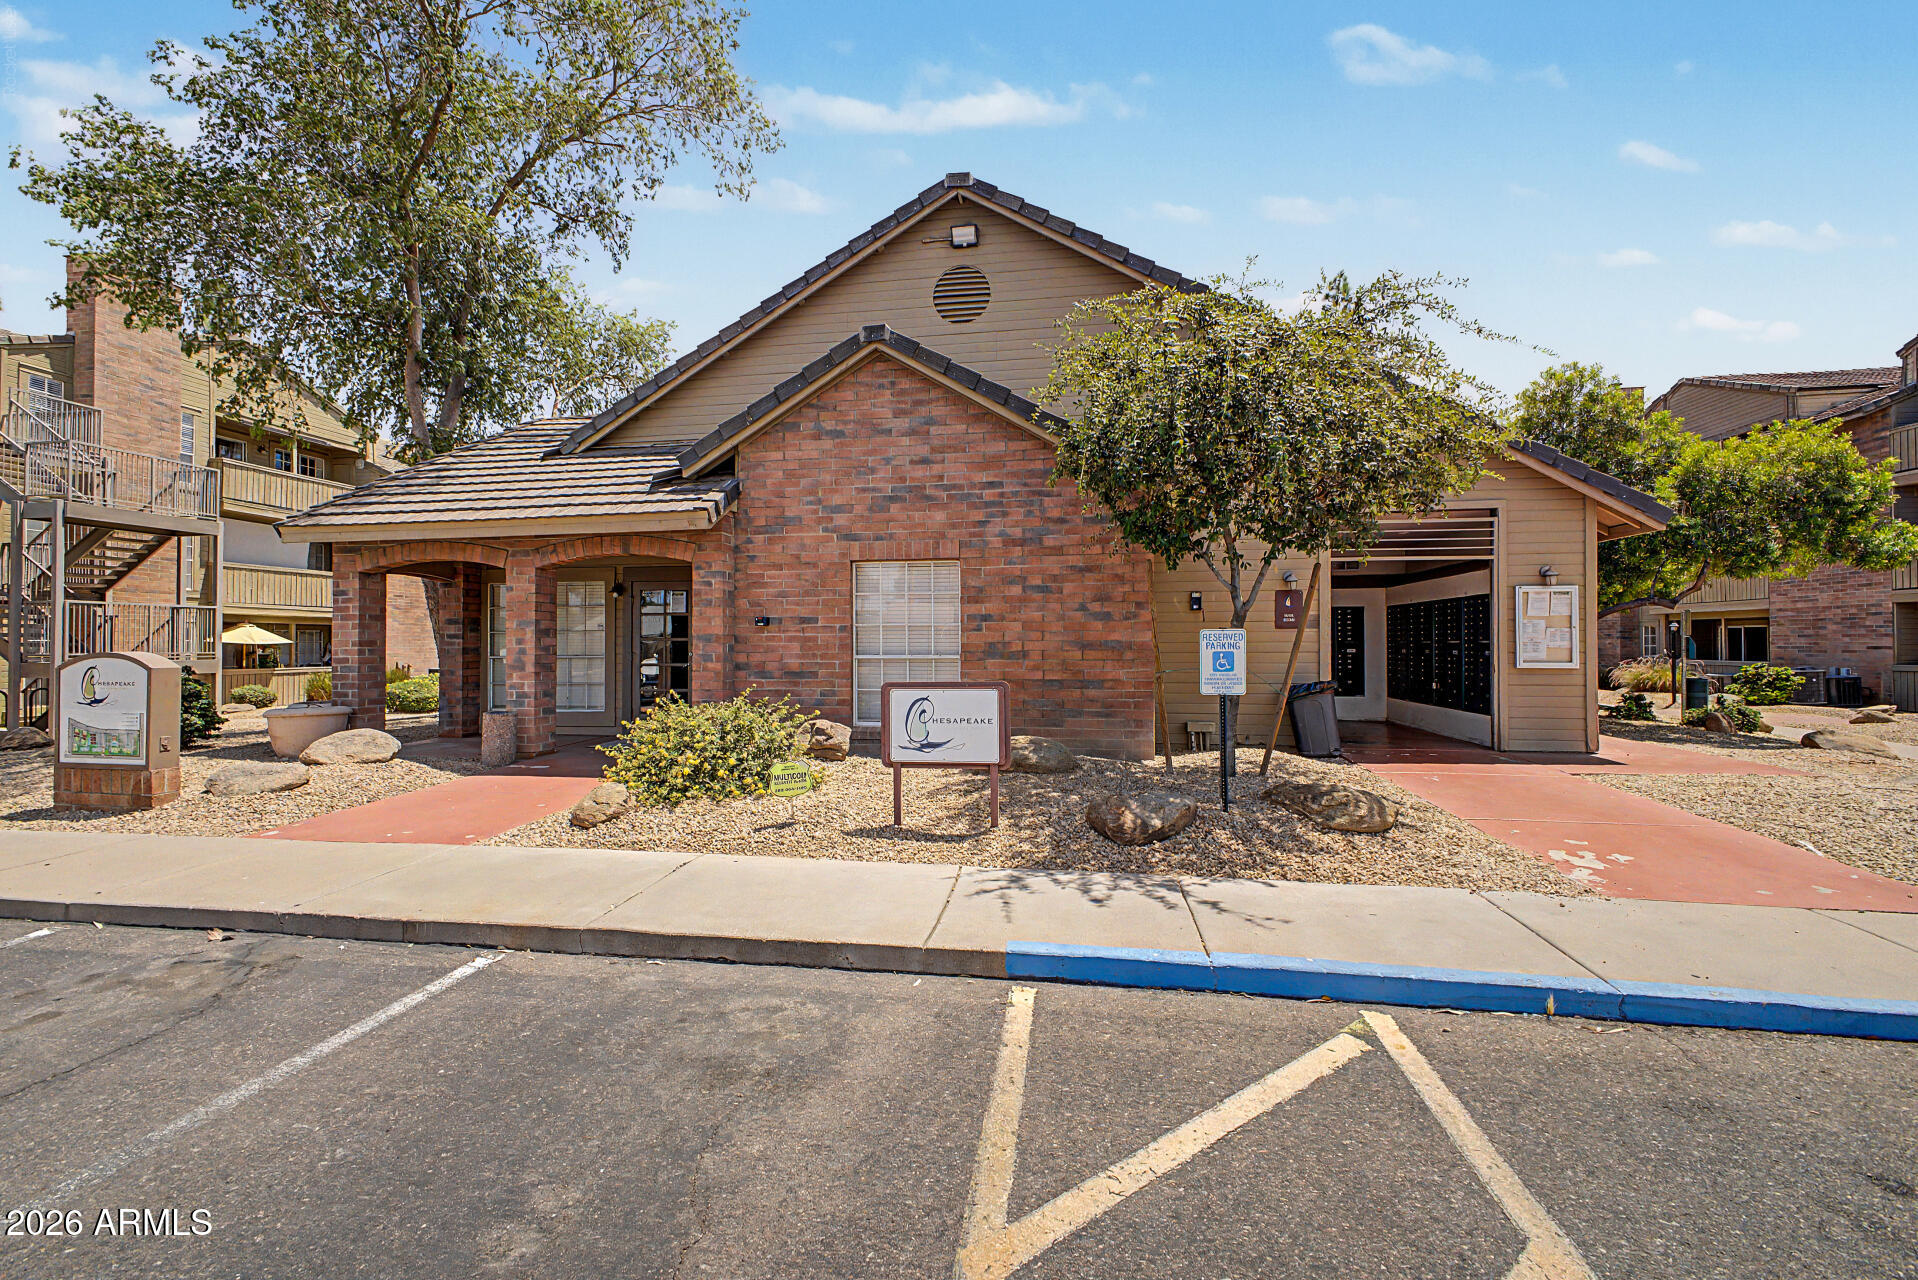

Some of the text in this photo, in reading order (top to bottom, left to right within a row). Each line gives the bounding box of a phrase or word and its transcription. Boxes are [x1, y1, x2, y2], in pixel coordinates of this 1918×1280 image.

[1202, 633, 1244, 642] RESERVED
[1205, 641, 1241, 650] PARKING
[905, 695, 994, 743] CHESAPEAKE
